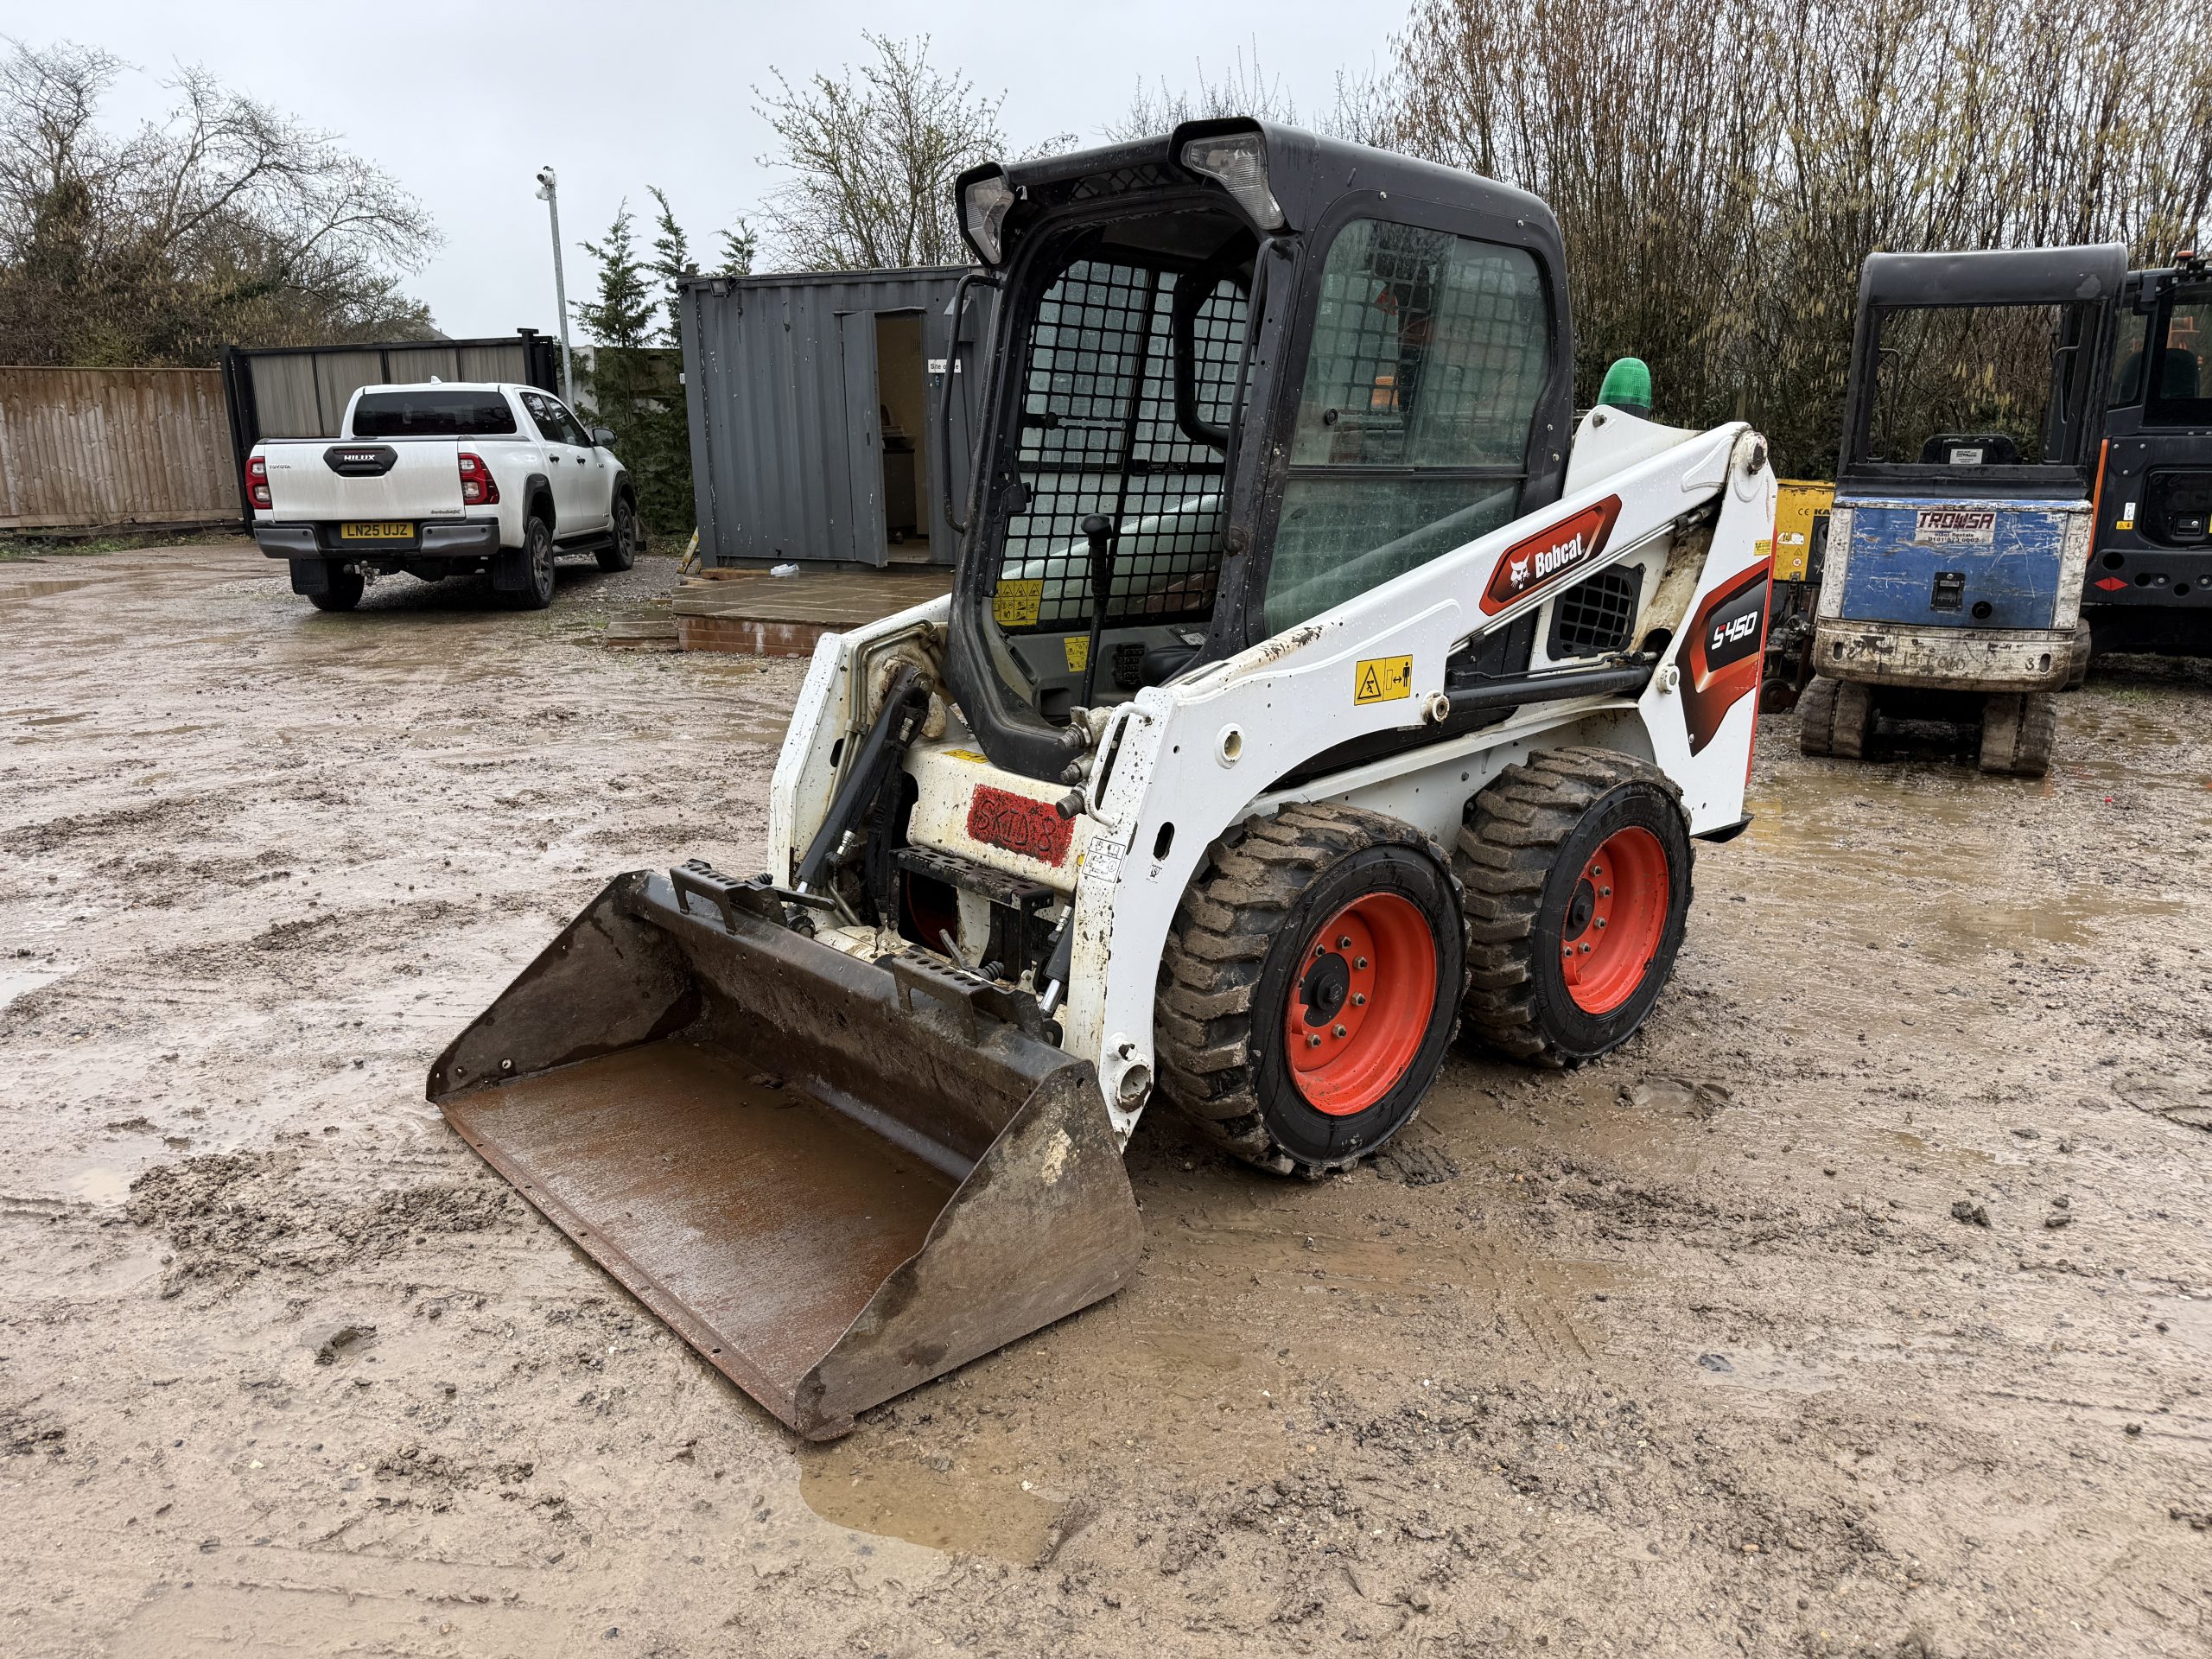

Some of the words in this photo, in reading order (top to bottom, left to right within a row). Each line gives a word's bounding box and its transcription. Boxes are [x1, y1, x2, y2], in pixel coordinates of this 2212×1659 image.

[347, 524, 380, 537] LN25
[383, 524, 408, 536] UJZ
[1919, 512, 1995, 530] TROWSA
[1535, 531, 1583, 579] Bobcat
[1711, 610, 1758, 651] S450
